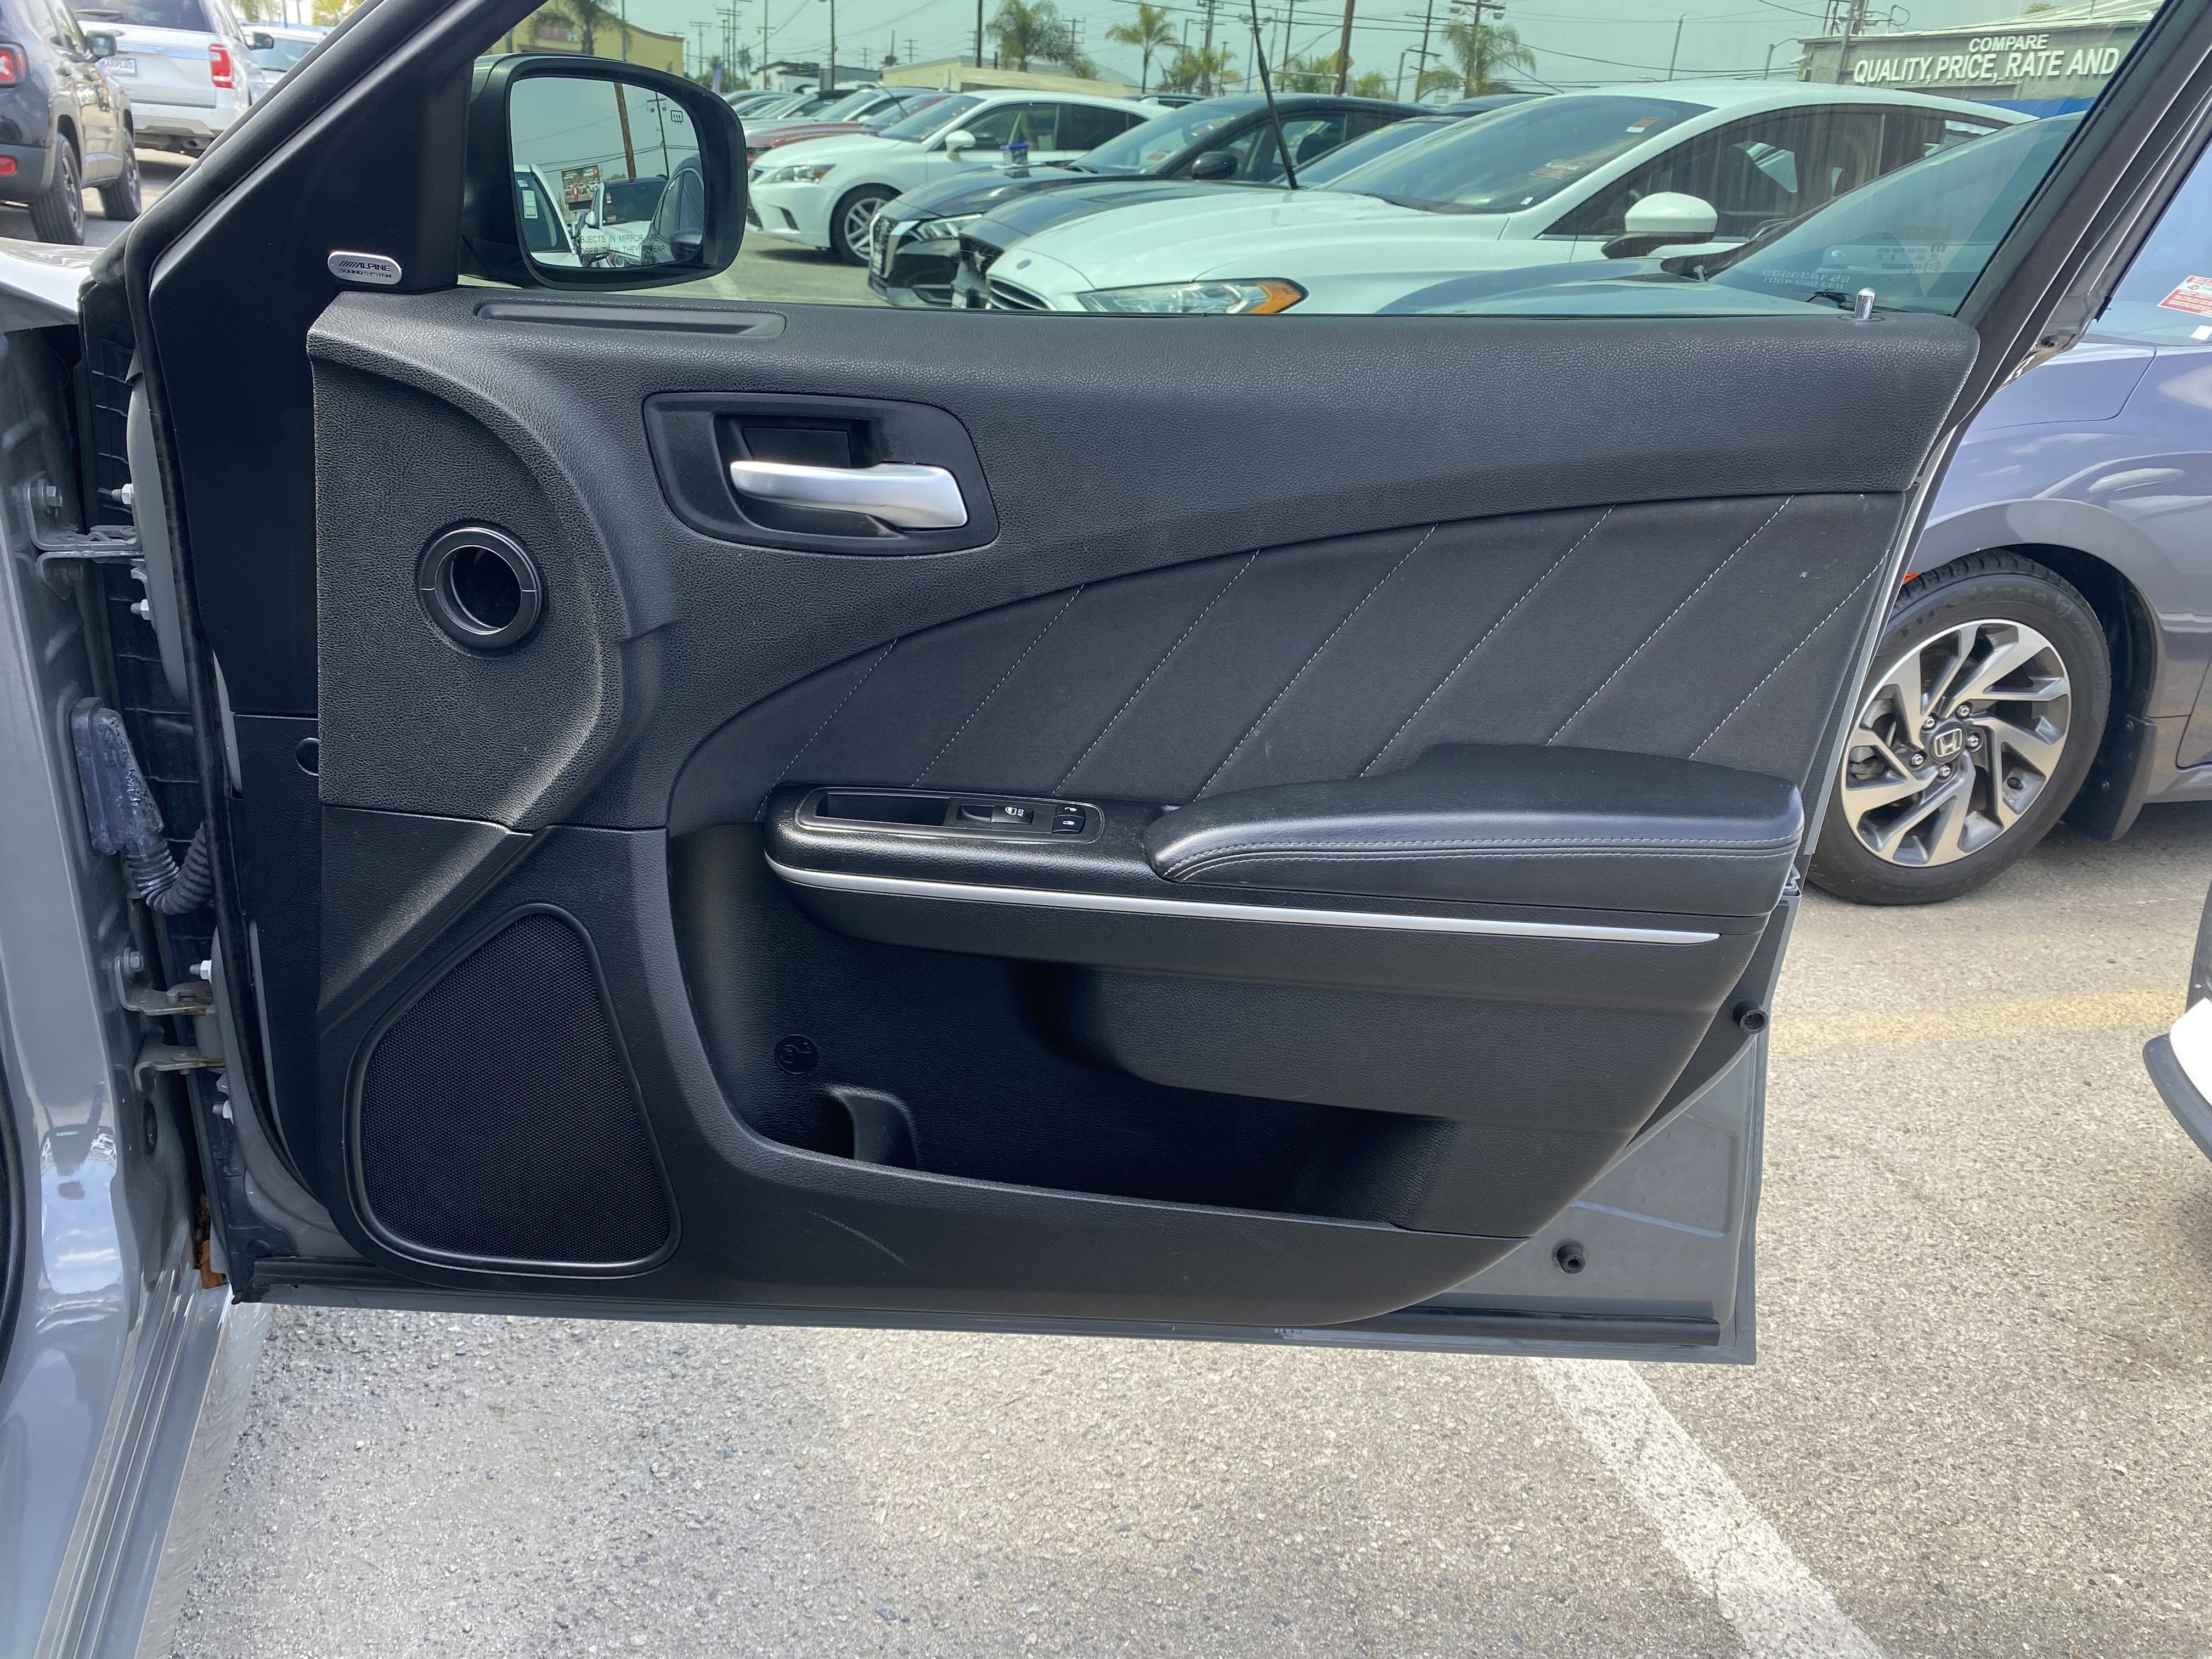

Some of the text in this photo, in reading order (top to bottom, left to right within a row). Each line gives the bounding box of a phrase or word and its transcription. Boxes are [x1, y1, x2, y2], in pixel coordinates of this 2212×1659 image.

[1968, 33, 2049, 53] COMPARE
[1854, 47, 2120, 84] QUALITY, PRICE, RATE AND
[571, 247, 599, 256] COSER
[355, 262, 391, 272] ALPINE
